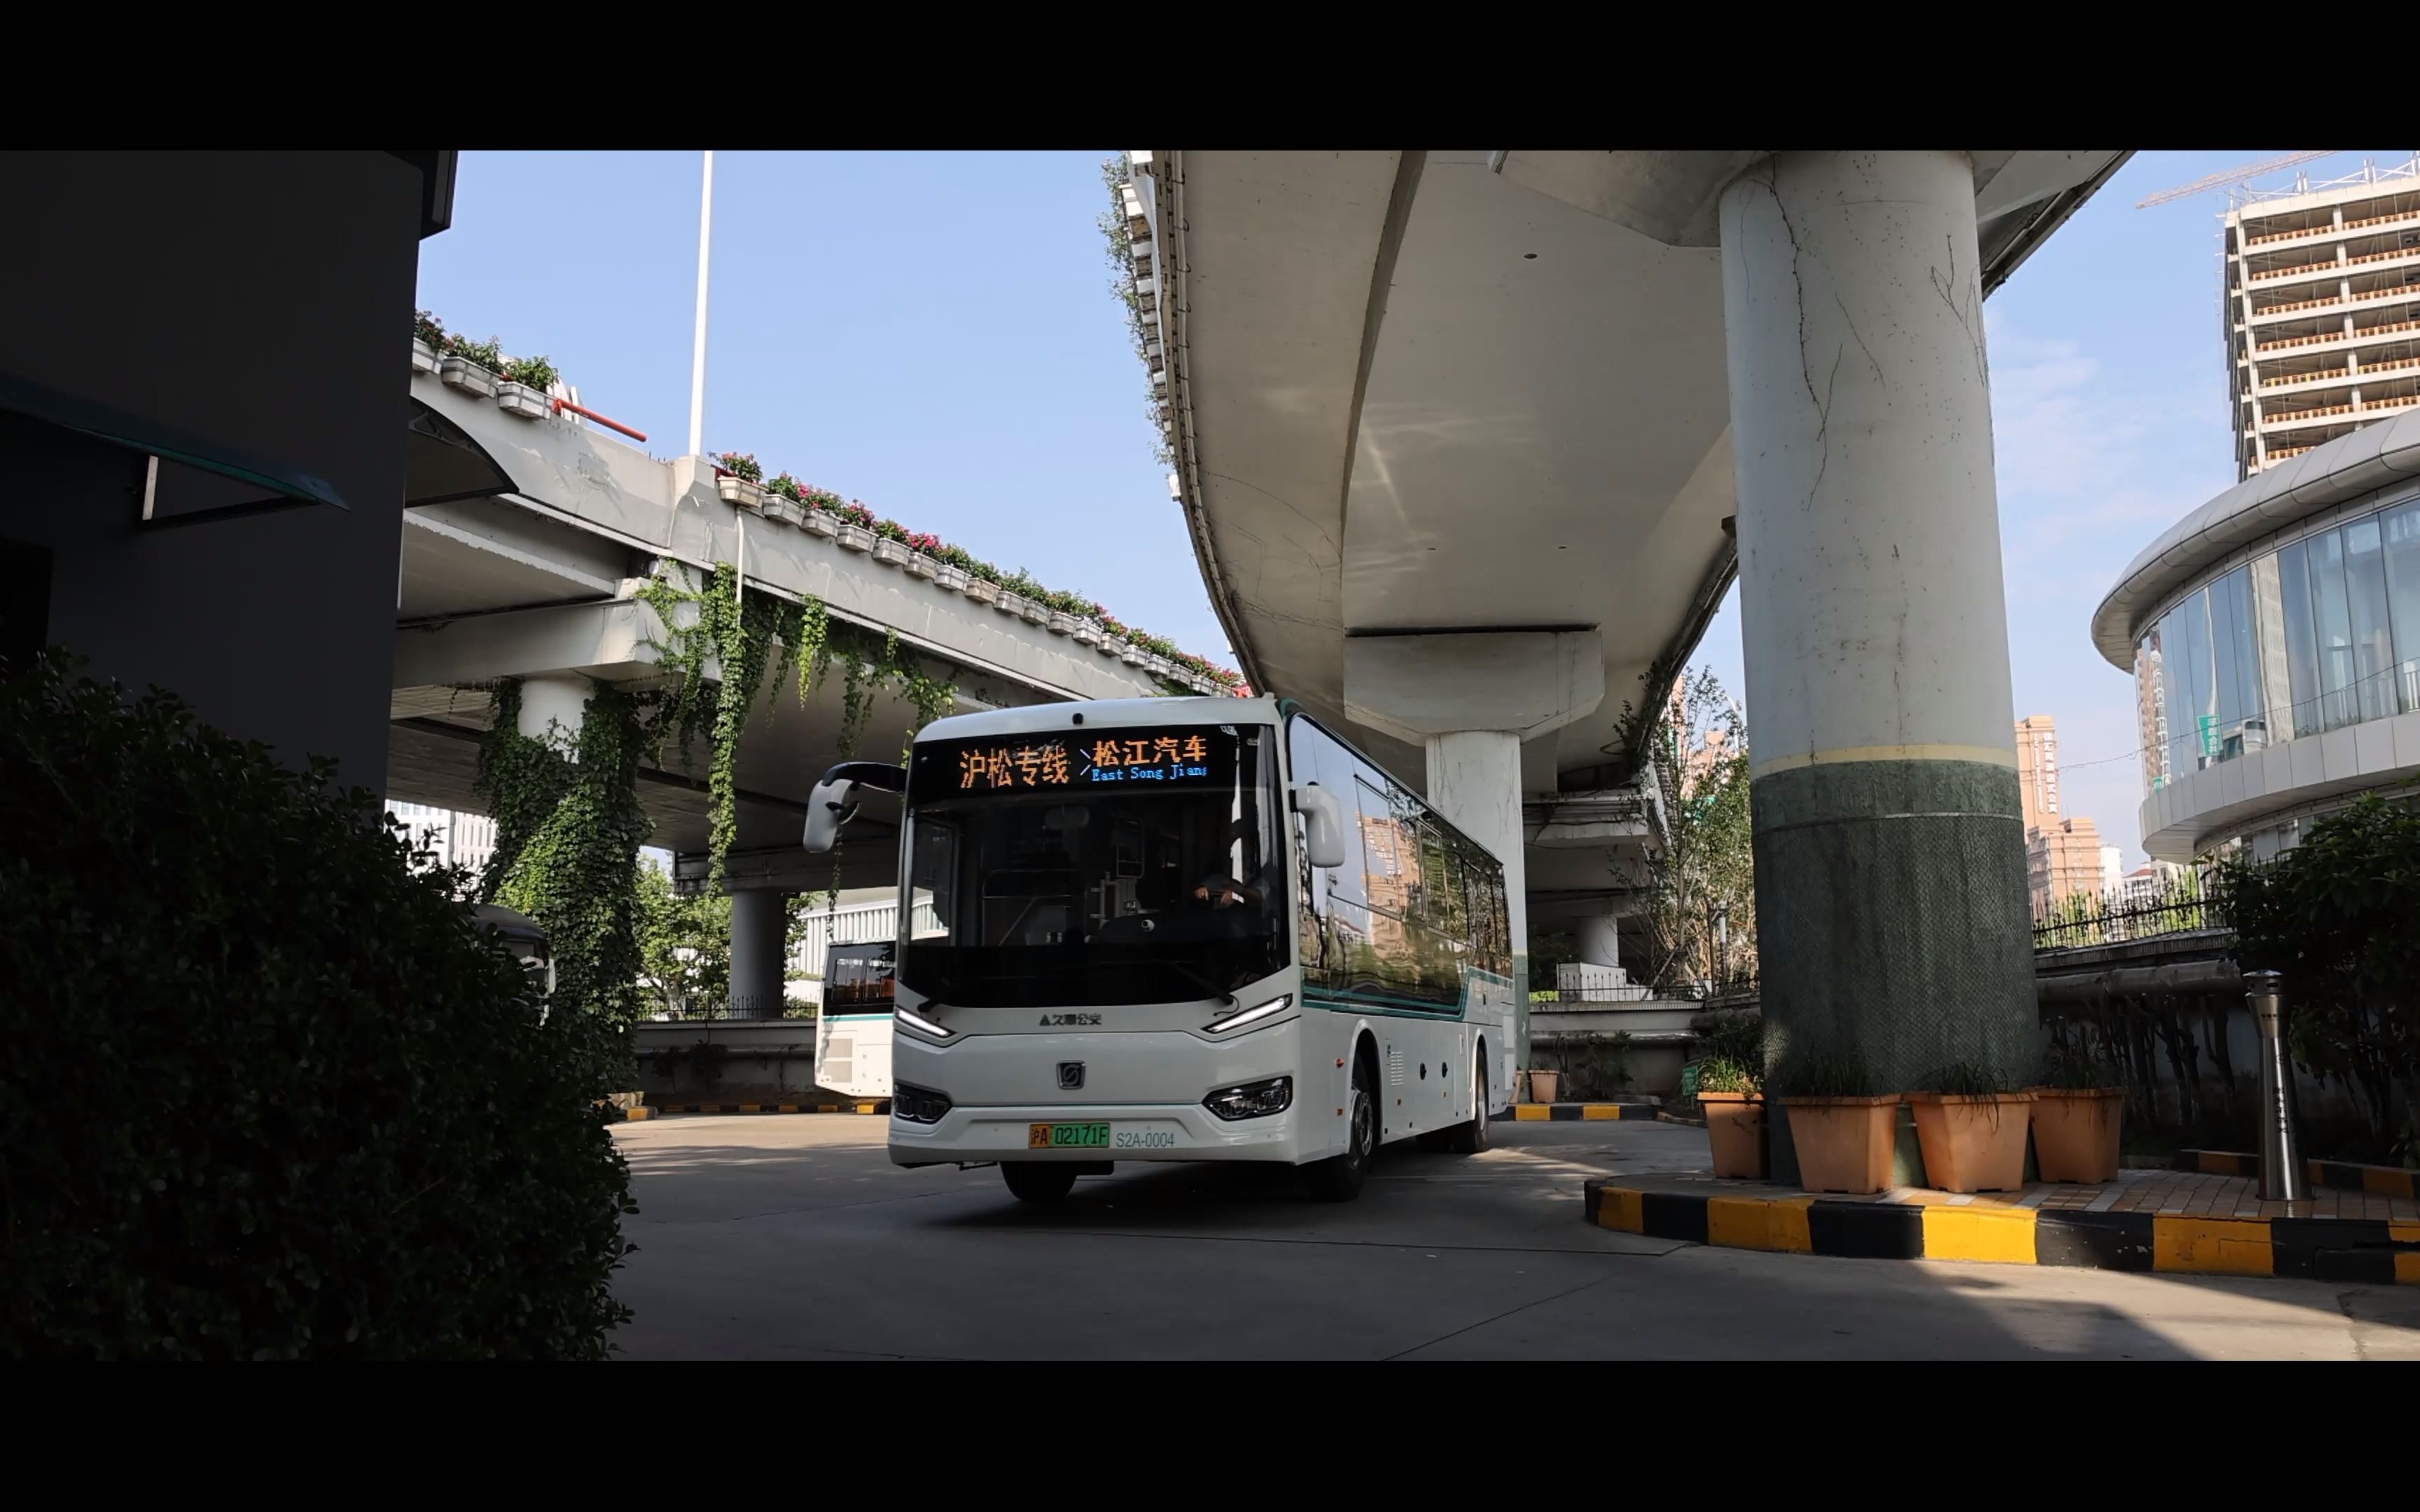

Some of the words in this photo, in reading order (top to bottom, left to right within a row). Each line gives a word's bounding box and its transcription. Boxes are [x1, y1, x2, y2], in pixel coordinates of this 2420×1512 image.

[1092, 735, 1206, 767] 松江汽车
[960, 745, 1069, 788] 沪松专线
[1092, 769, 1124, 781] East
[1131, 767, 1164, 780] Song
[1116, 1133, 1174, 1148] S2A-0004
